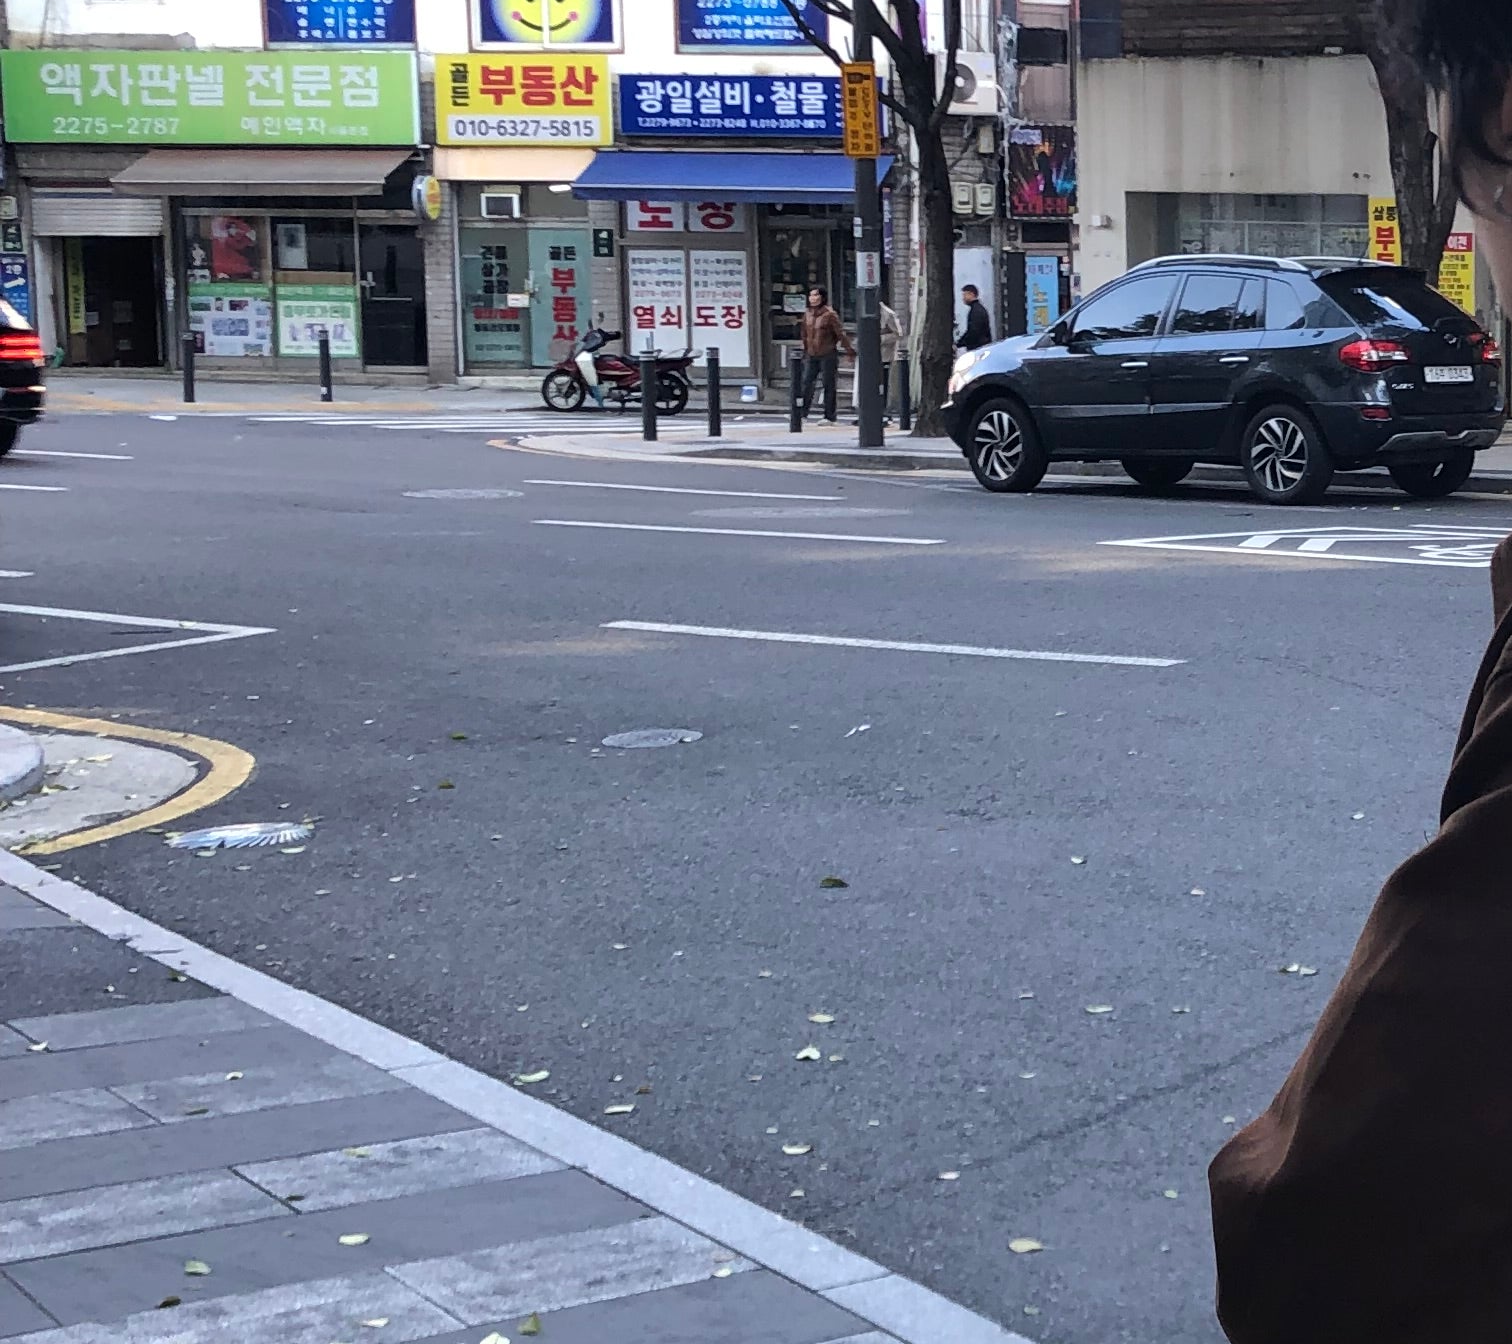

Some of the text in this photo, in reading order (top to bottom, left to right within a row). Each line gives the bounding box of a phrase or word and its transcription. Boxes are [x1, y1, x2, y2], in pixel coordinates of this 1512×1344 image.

[40, 63, 380, 108] 액자판넬 전문점
[450, 62, 469, 107] 골든
[479, 64, 600, 107] 부동산
[53, 116, 180, 135] 2275-2787
[455, 119, 595, 137] 010-6327-5815
[633, 304, 746, 330] 열쇠 도장
